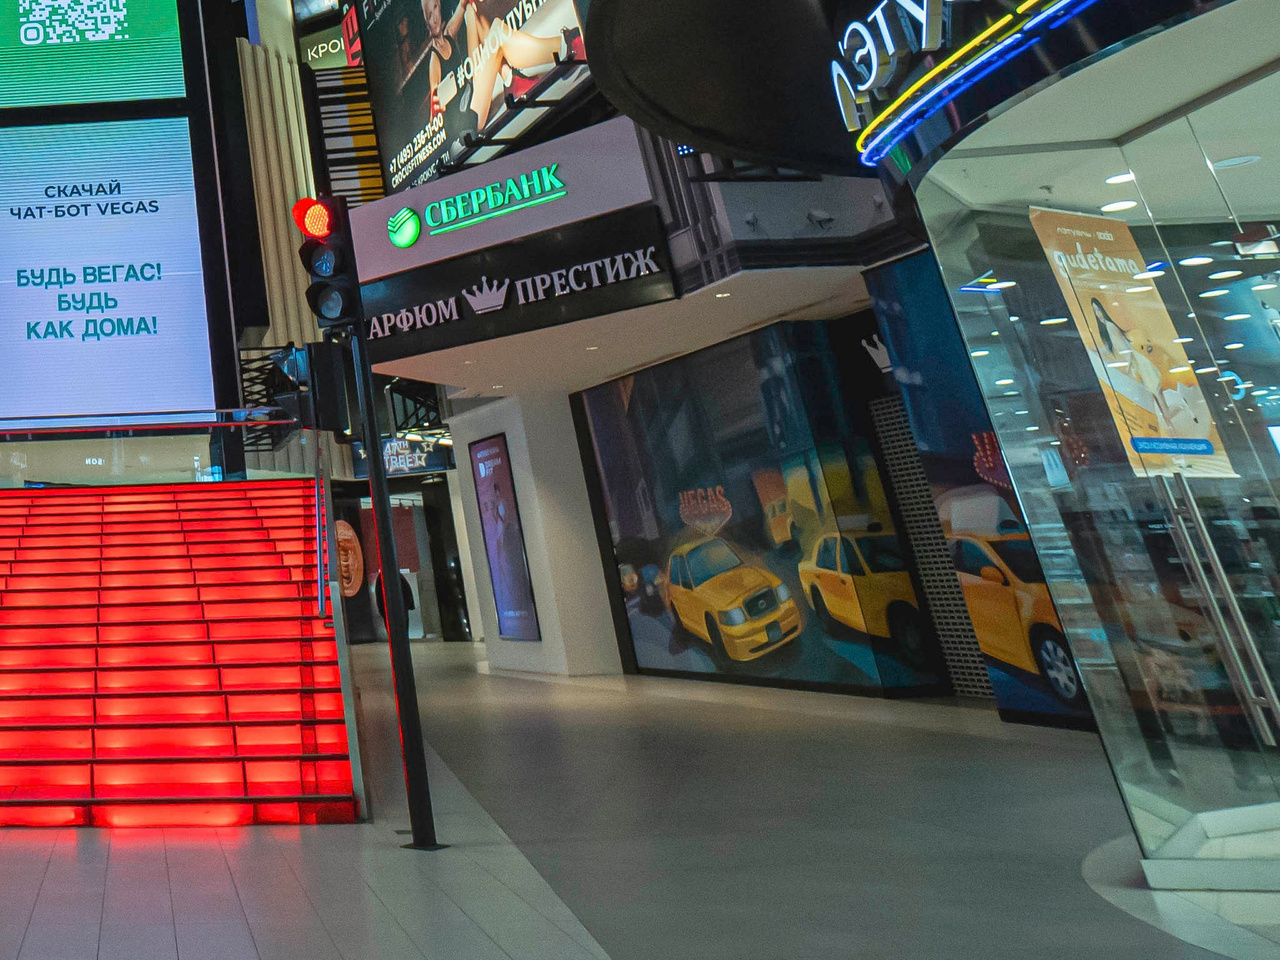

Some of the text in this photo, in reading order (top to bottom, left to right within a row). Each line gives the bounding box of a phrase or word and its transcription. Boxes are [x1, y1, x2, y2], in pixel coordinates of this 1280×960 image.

[391, 128, 447, 189] CROCUSFITNESS.COM
[397, 143, 414, 169] (495)
[44, 179, 121, 198] СКАЧАЙ
[424, 162, 565, 228] СБЕРБАНК
[10, 200, 159, 220] ЧАТ-БОТ VEGAS
[1052, 241, 1141, 279] gudetama
[16, 263, 162, 288] БУДЬ ВЕГАС!
[57, 292, 118, 313] БУДЬ
[367, 245, 661, 340] АРФЮМ ПРЕСТИЖ
[26, 316, 158, 340] КАК ДОМА!
[383, 453, 420, 470] TREET
